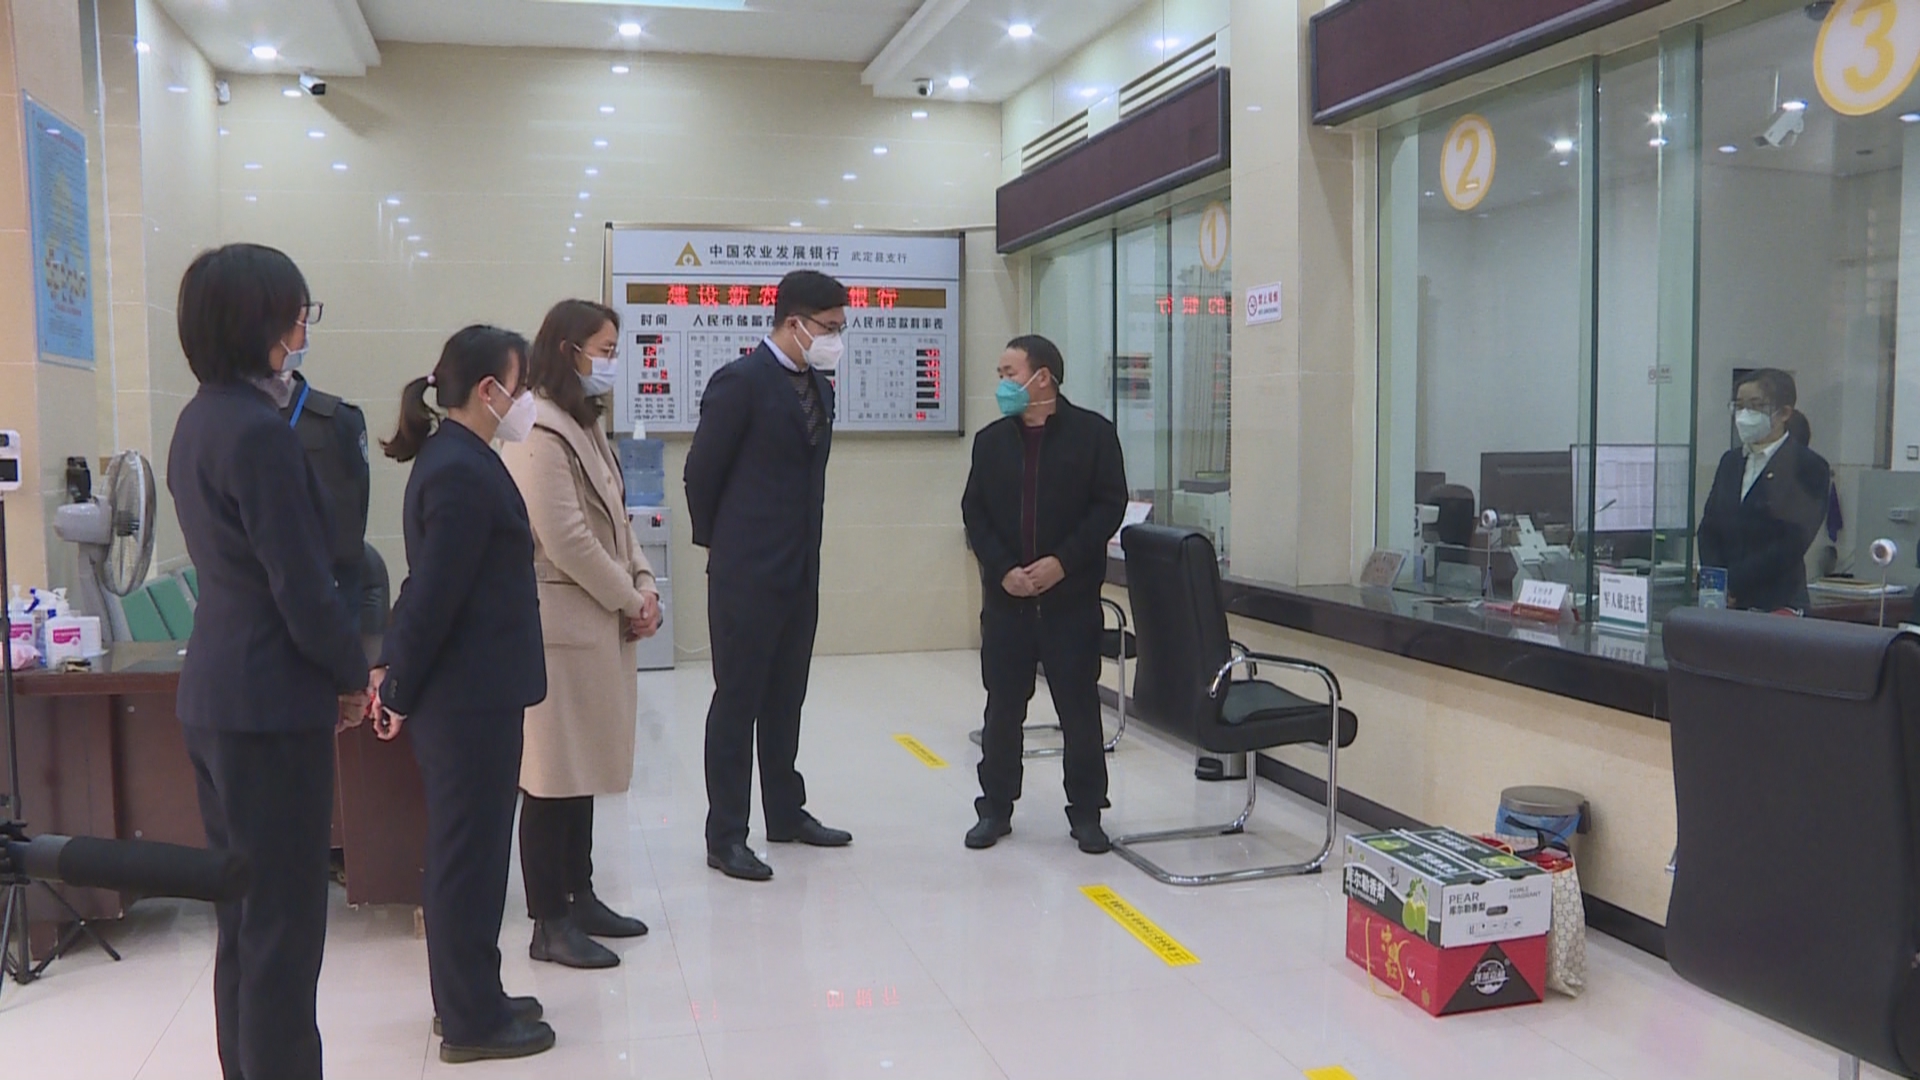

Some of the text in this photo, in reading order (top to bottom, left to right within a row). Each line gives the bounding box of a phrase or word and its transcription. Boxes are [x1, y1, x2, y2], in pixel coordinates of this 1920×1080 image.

[1843, 0, 1897, 93] 3
[1455, 128, 1480, 196] 2
[1207, 211, 1217, 260] 1
[710, 244, 839, 260] 中国农业发展银行
[851, 250, 907, 264] 武定县支行
[641, 313, 667, 327] 时间
[852, 315, 944, 330] 人民币贷款利率表
[1346, 867, 1386, 903] 库尔勒香梨
[1448, 892, 1480, 905] PEAR
[1449, 902, 1486, 916] 库尔勒香梨
